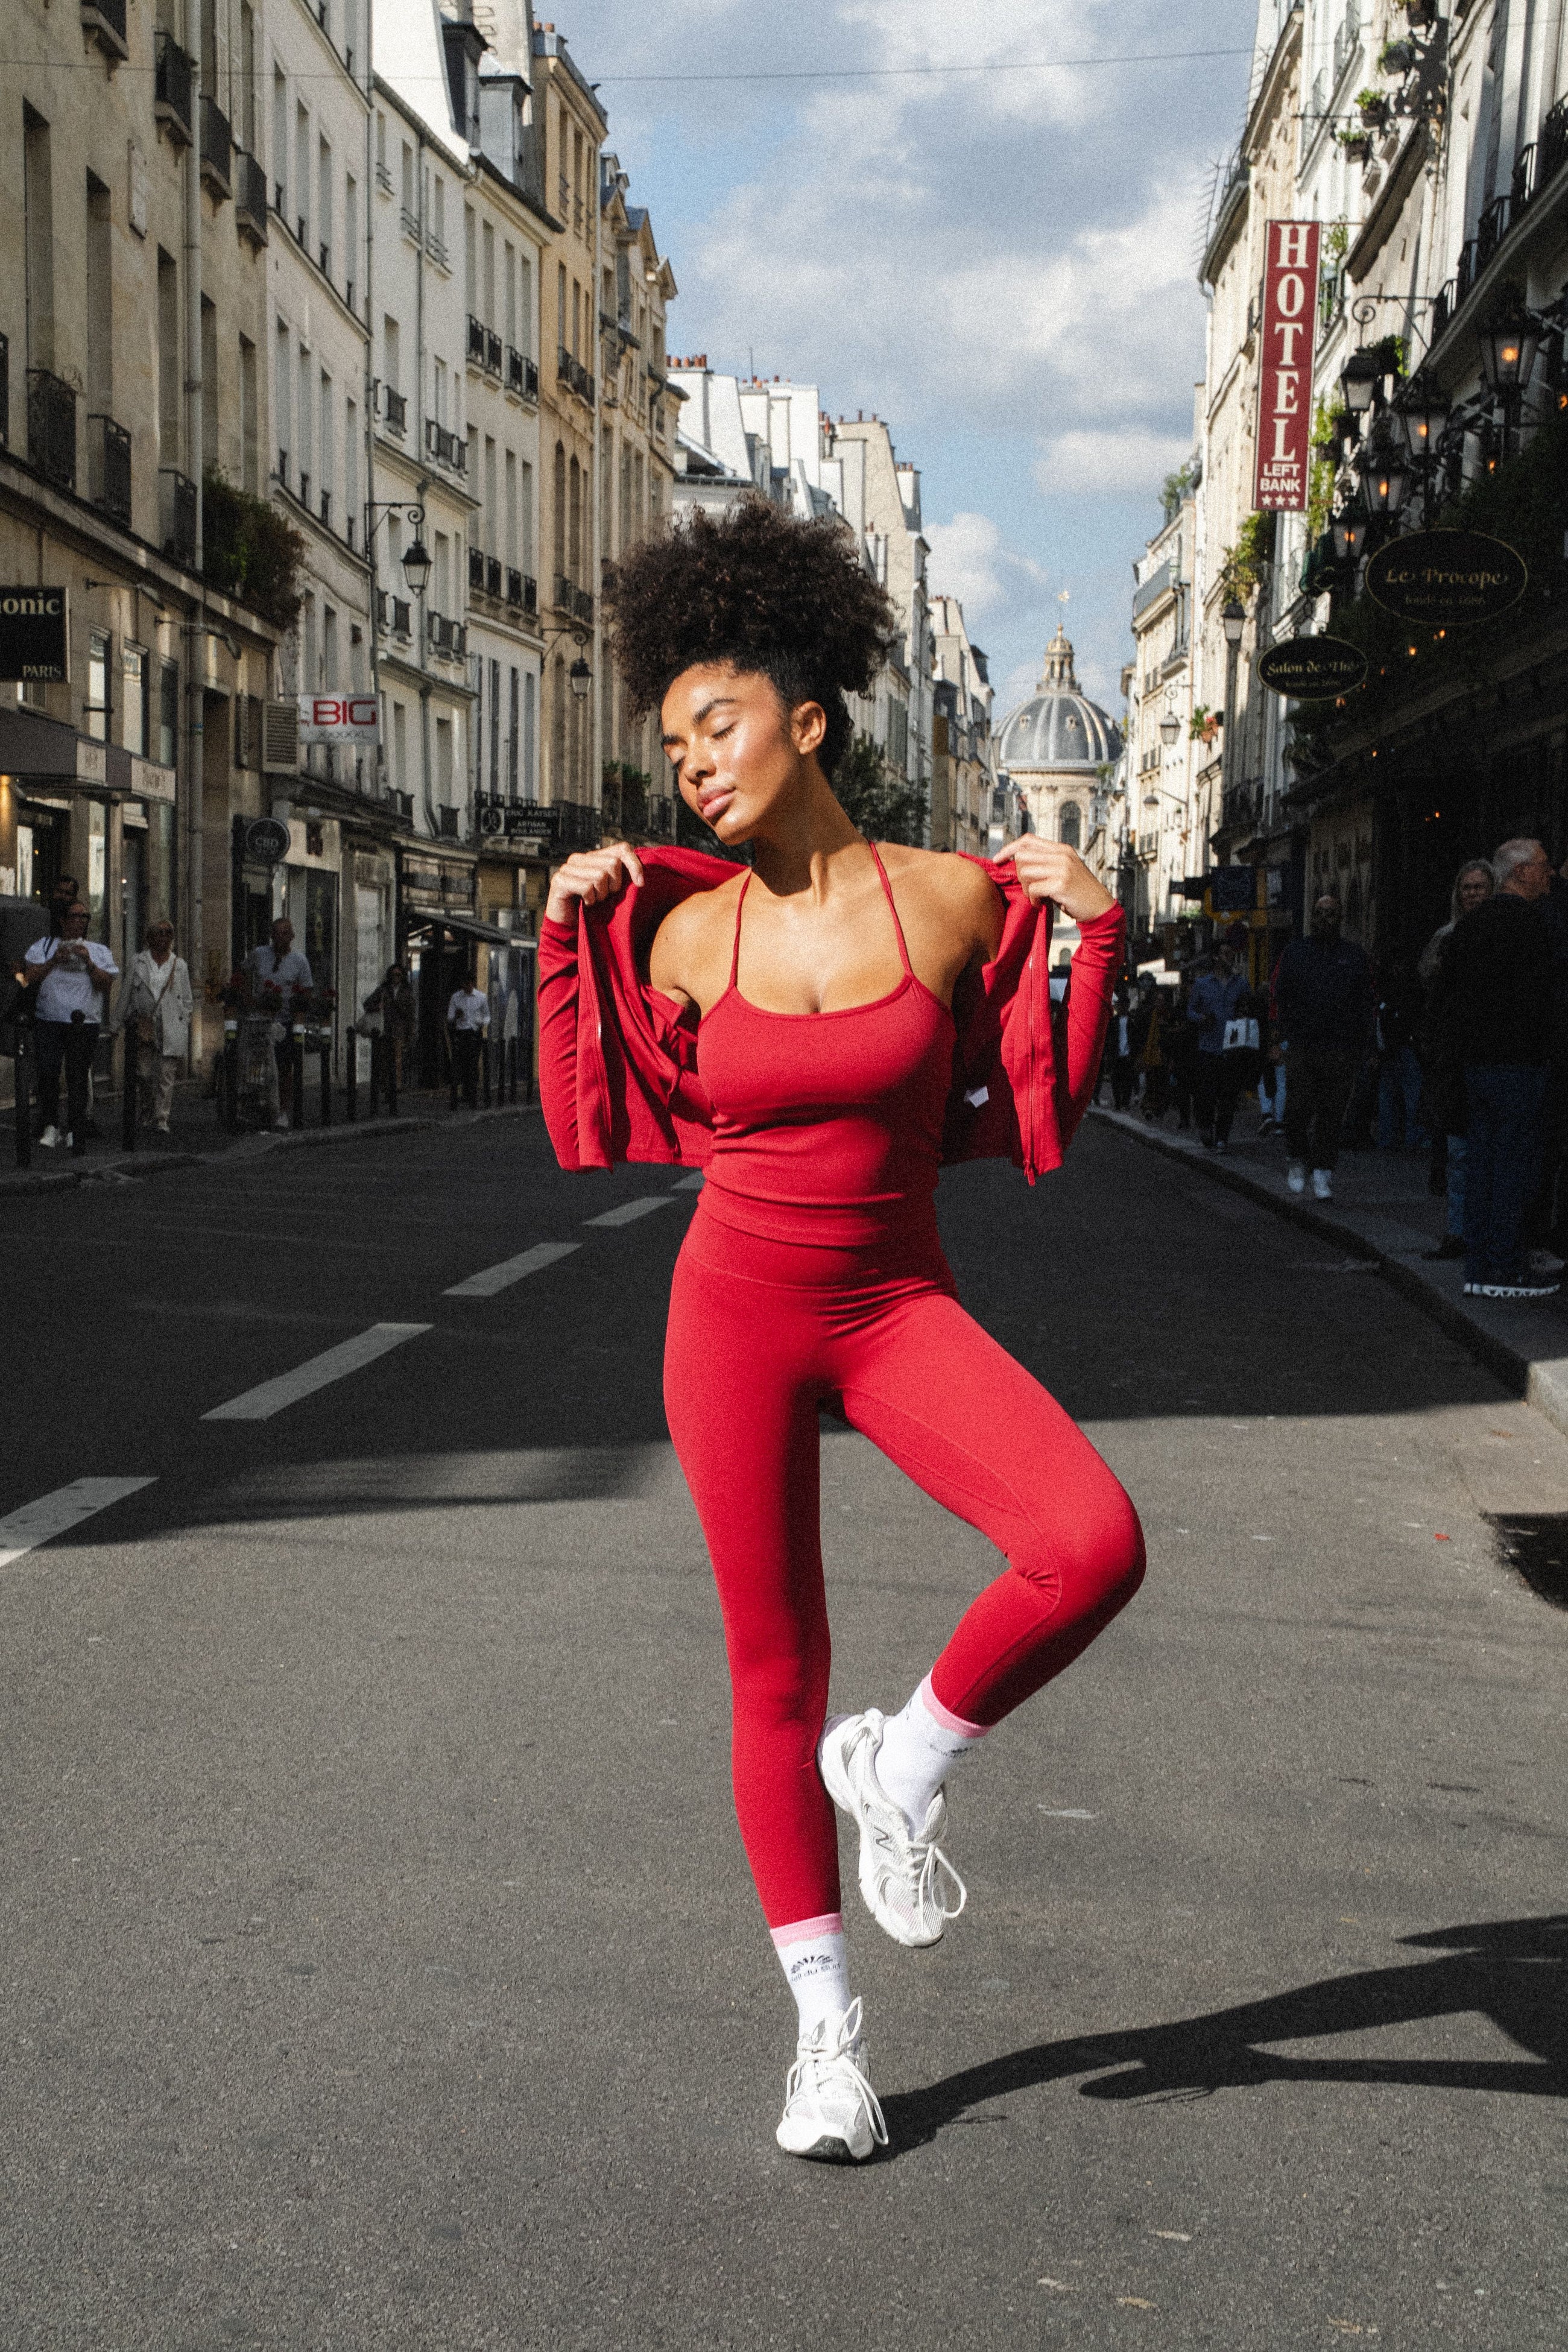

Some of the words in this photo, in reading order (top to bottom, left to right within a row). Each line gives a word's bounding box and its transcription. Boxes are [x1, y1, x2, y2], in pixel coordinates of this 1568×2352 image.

[1271, 224, 1311, 462] HOTEL
[1263, 463, 1301, 477] LEFT
[1260, 478, 1301, 492] BANK
[1385, 567, 1415, 584] Le
[1422, 567, 1509, 589] Procope
[0, 592, 60, 615] onic
[22, 665, 62, 677] PARIS
[1266, 662, 1303, 677] Salon
[1307, 660, 1320, 673] de
[313, 700, 376, 726] BIG
